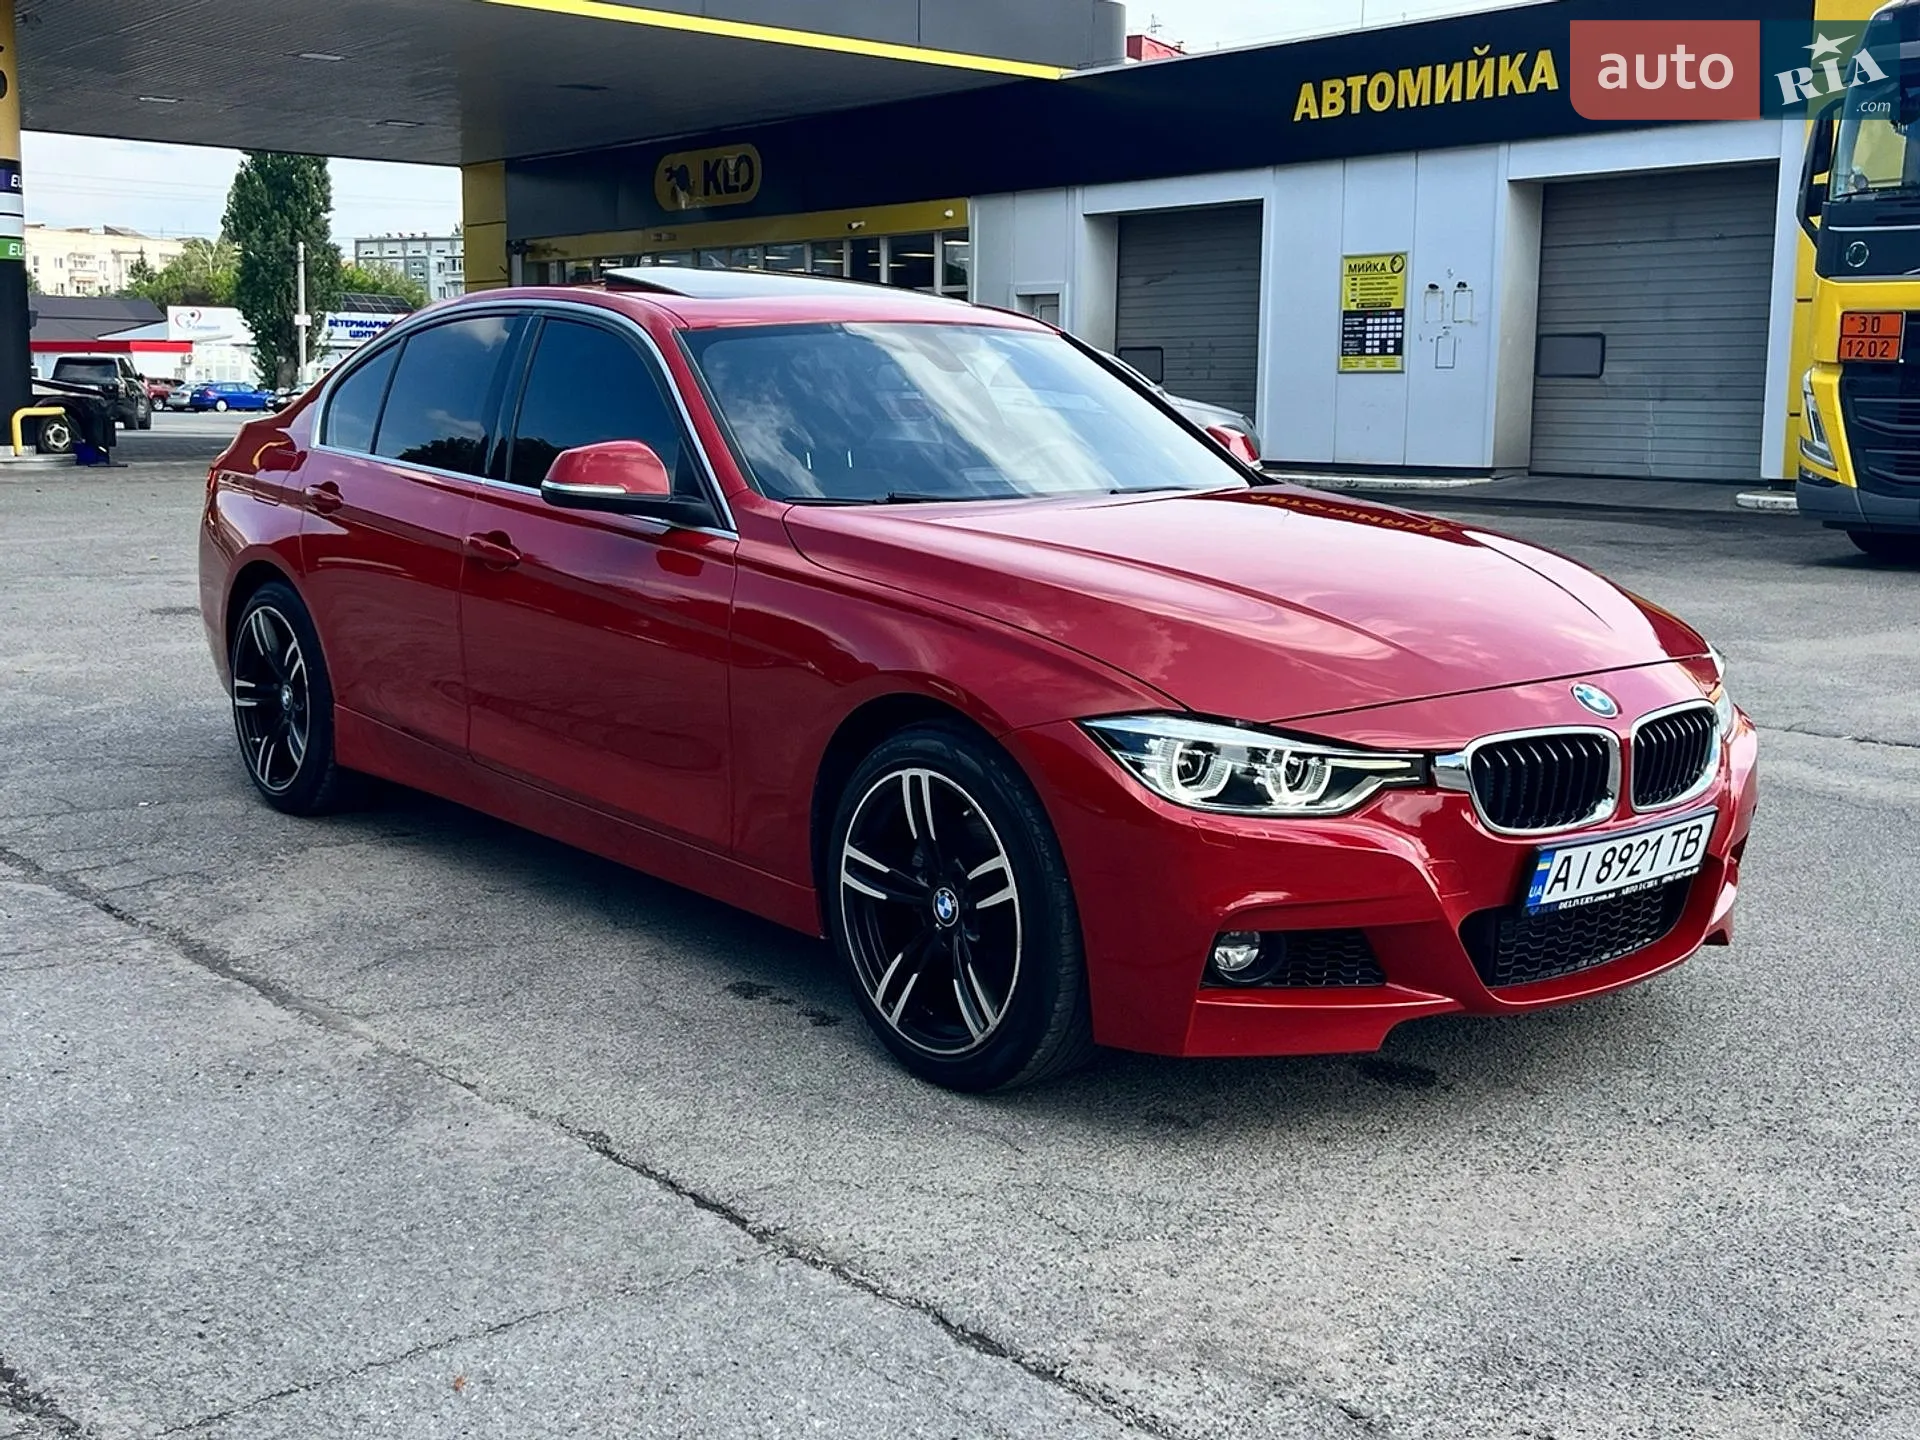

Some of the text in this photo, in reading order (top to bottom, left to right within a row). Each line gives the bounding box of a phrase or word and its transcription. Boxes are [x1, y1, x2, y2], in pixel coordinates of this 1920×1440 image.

[1293, 44, 1560, 122] АВТОМИЙКА
[703, 154, 754, 196] KLO
[1348, 261, 1387, 273] МИЙКА
[1858, 316, 1881, 334] 30
[1846, 340, 1890, 357] 1202
[1547, 851, 1592, 895] AI
[1596, 834, 1664, 884] 8921
[1668, 823, 1703, 866] TB
[1528, 885, 1543, 898] UA
